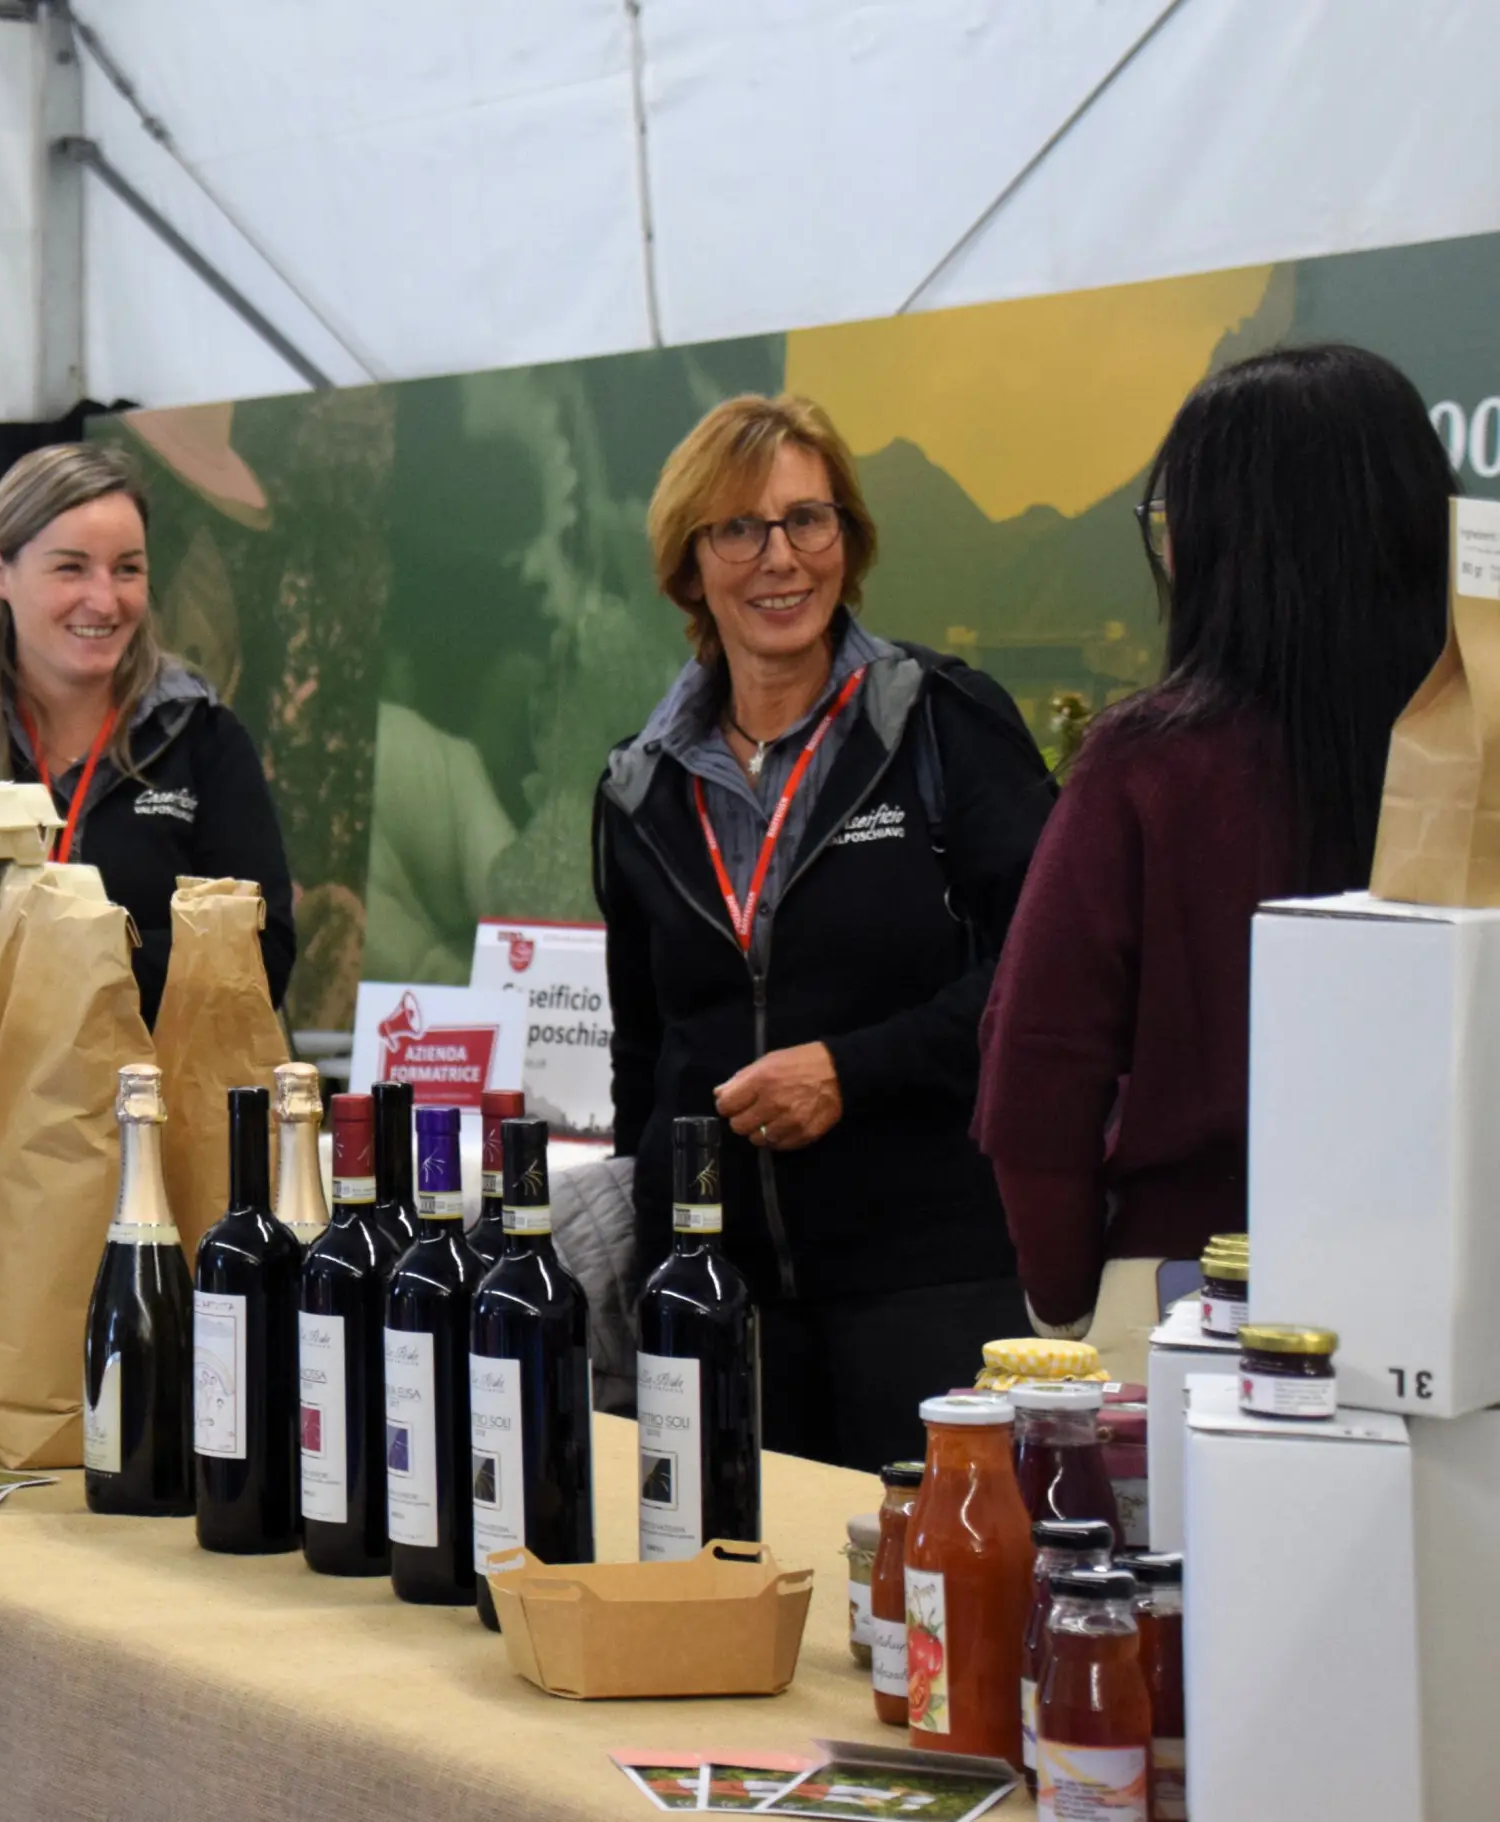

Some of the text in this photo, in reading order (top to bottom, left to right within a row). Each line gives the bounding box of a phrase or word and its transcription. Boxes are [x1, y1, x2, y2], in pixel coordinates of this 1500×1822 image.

[527, 1022, 614, 1048] poschia
[404, 1045, 468, 1062] AZIENDA
[390, 1065, 482, 1083] FORMATRICE
